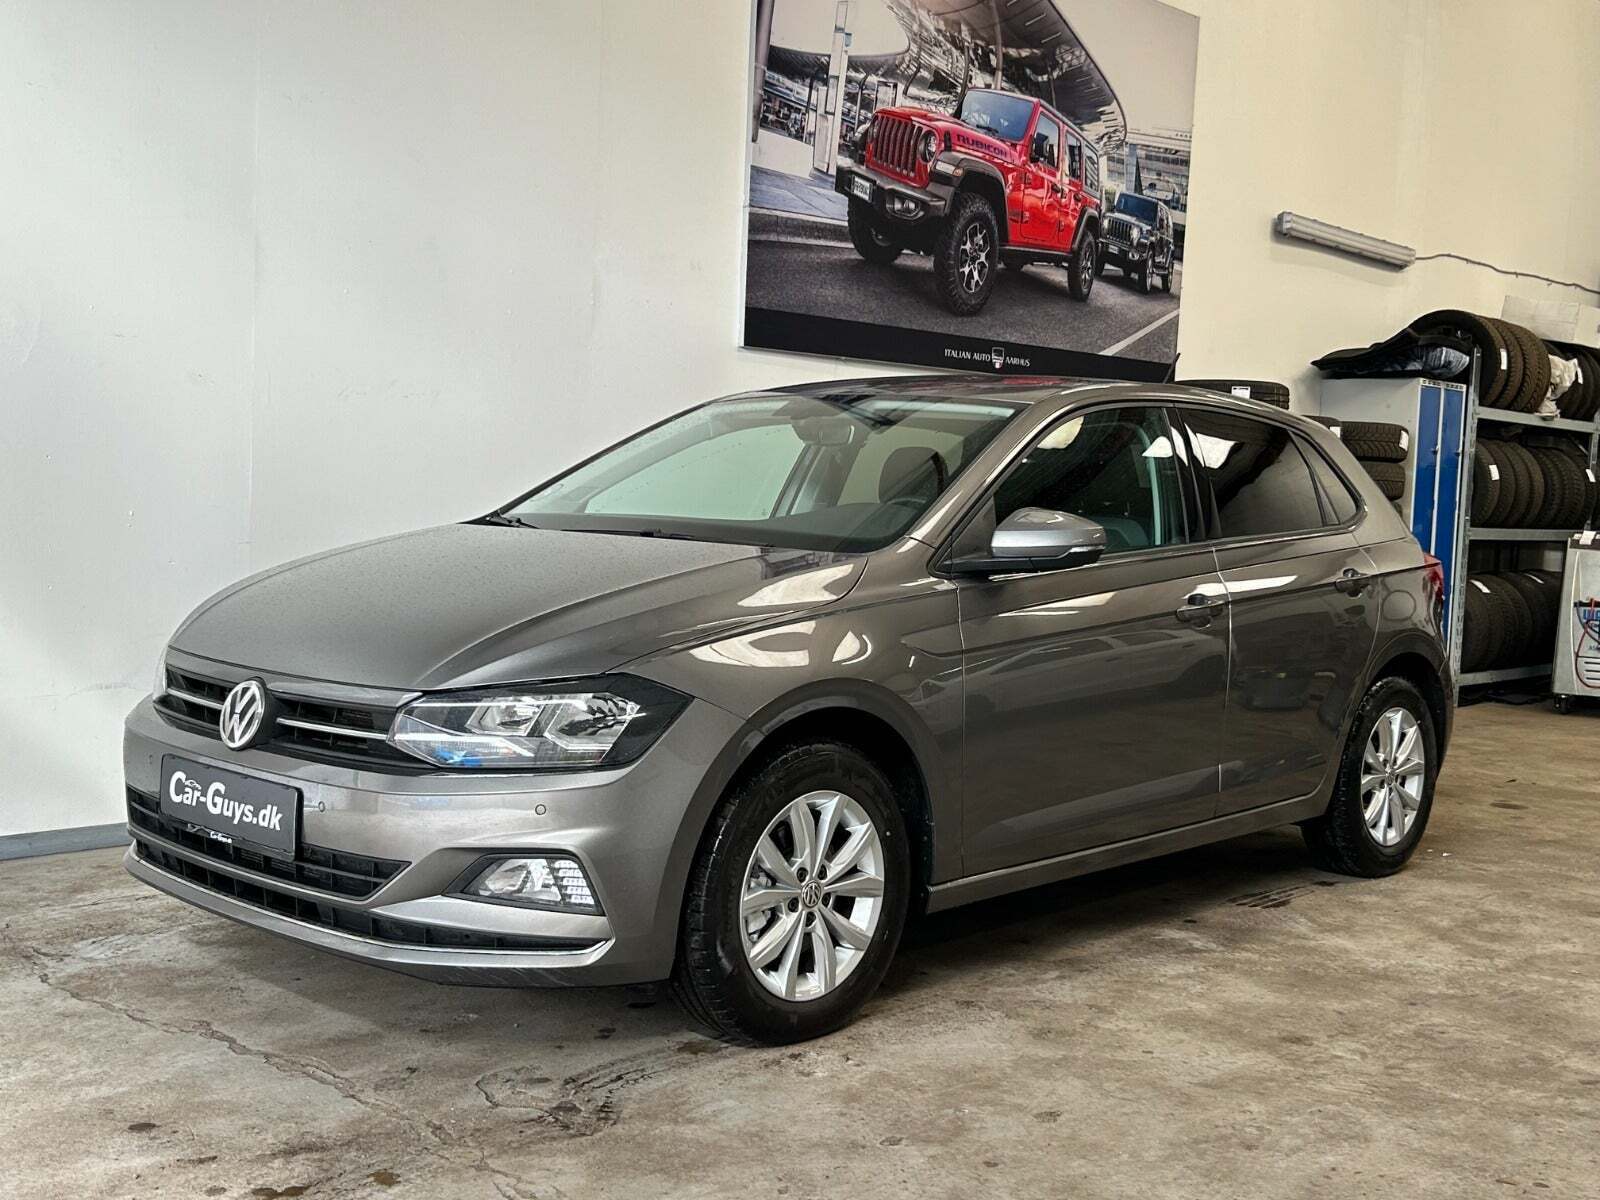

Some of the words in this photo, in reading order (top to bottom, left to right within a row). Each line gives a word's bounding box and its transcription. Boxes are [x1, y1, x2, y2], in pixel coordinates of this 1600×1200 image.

[956, 134, 1008, 158] RUBICON
[944, 348, 971, 360] ITALIAN
[972, 352, 991, 361] AUTO
[1005, 356, 1031, 367] AARHUS
[169, 770, 283, 831] Car-Guys.dk
